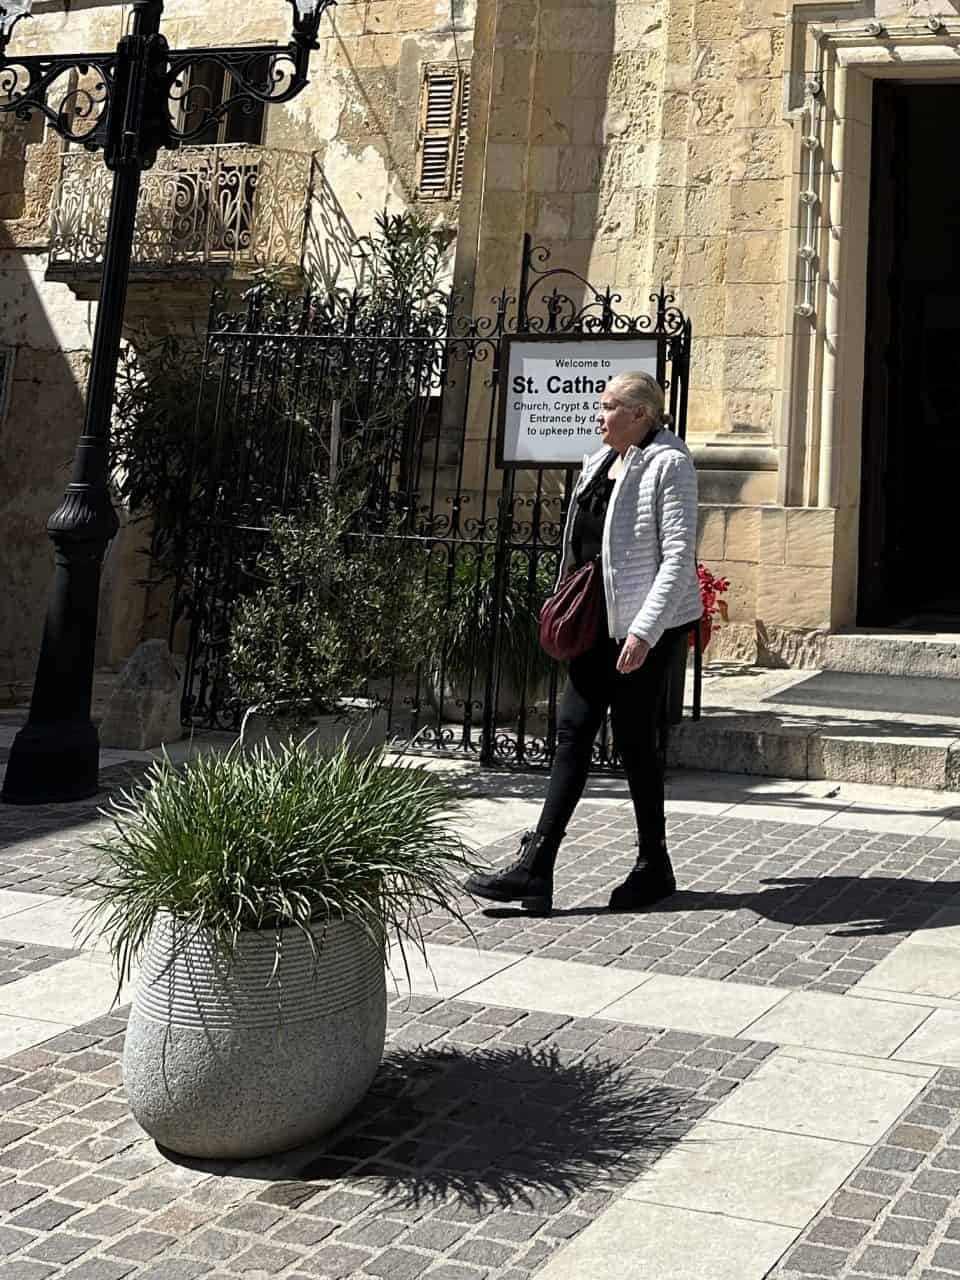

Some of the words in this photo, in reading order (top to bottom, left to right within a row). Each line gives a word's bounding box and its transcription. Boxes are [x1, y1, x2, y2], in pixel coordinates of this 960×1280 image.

[555, 360, 598, 368] Welcome
[601, 360, 611, 368] to
[512, 376, 539, 394] St.
[547, 376, 612, 394] Catha
[513, 401, 551, 412] Church,
[554, 401, 580, 413] Crypt
[582, 402, 590, 410] &
[530, 414, 572, 423] Entrance
[575, 414, 587, 425] by
[527, 427, 537, 435] to
[539, 426, 574, 437] upkeep
[577, 426, 592, 435] the
